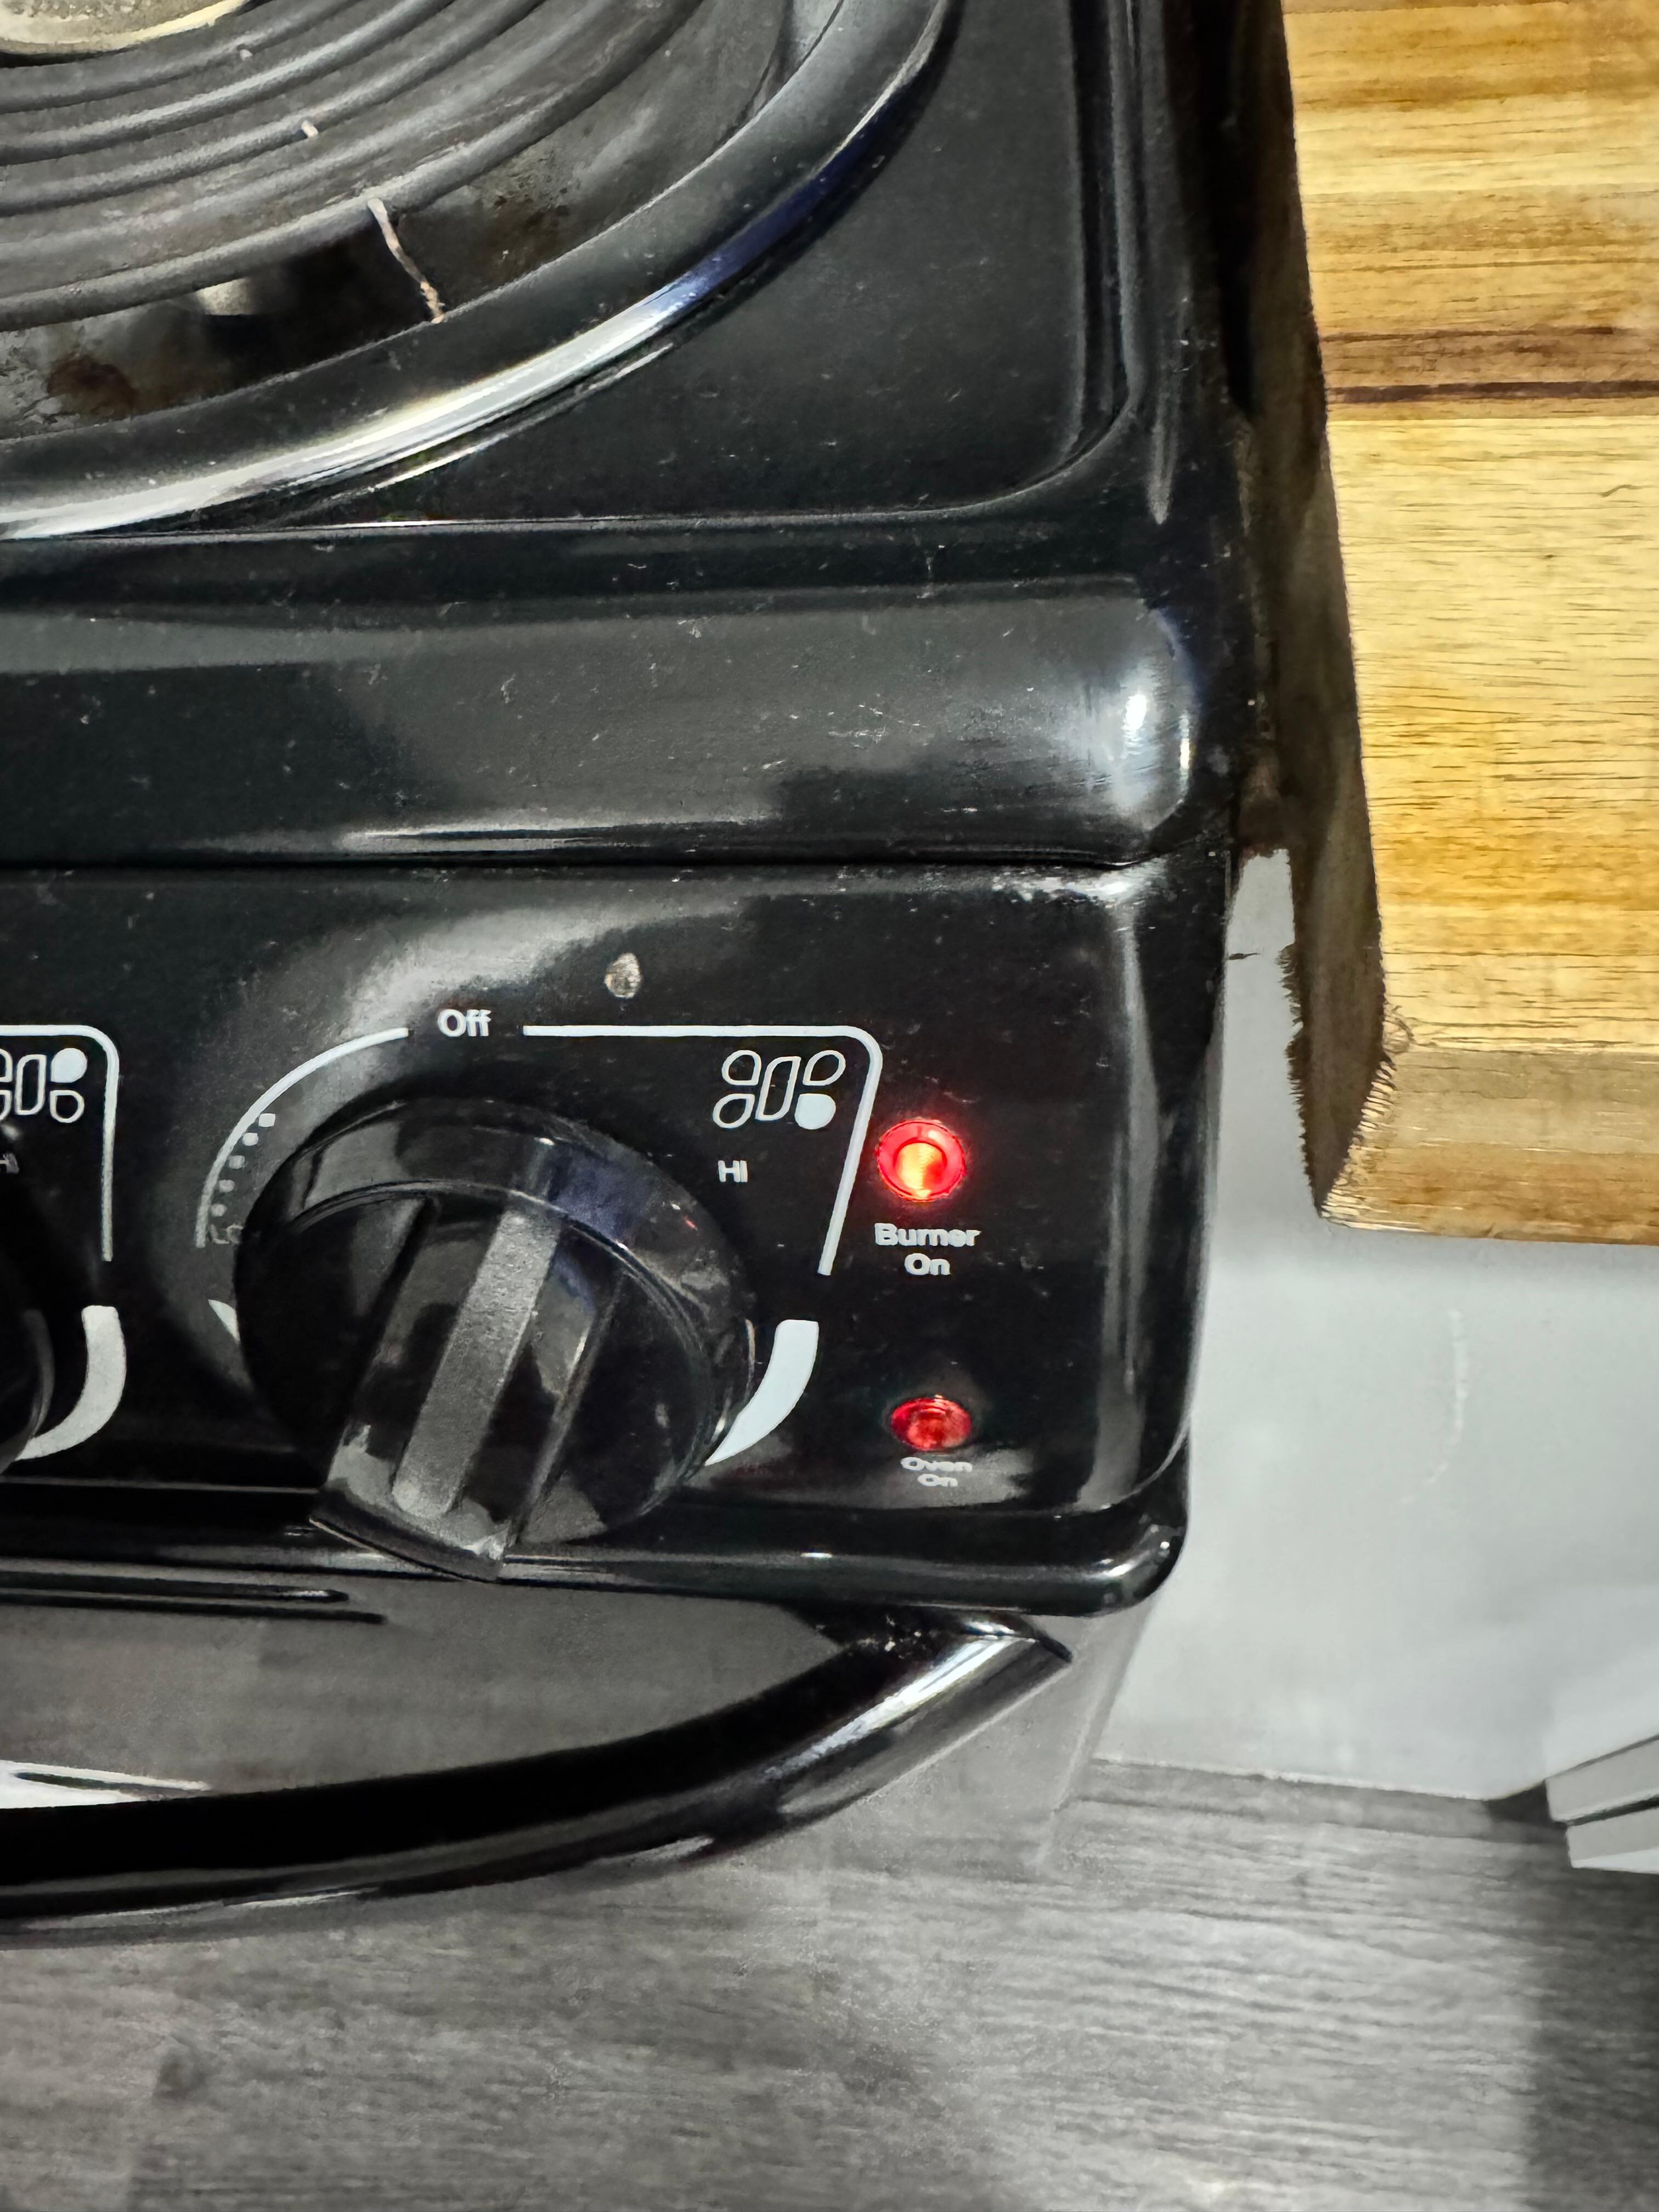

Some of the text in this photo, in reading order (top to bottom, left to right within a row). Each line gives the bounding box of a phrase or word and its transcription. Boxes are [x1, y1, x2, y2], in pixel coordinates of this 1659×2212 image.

[437, 1008, 492, 1037] Off
[874, 1222, 981, 1247] Burner
[904, 1252, 951, 1276] On
[917, 1474, 958, 1487] On
